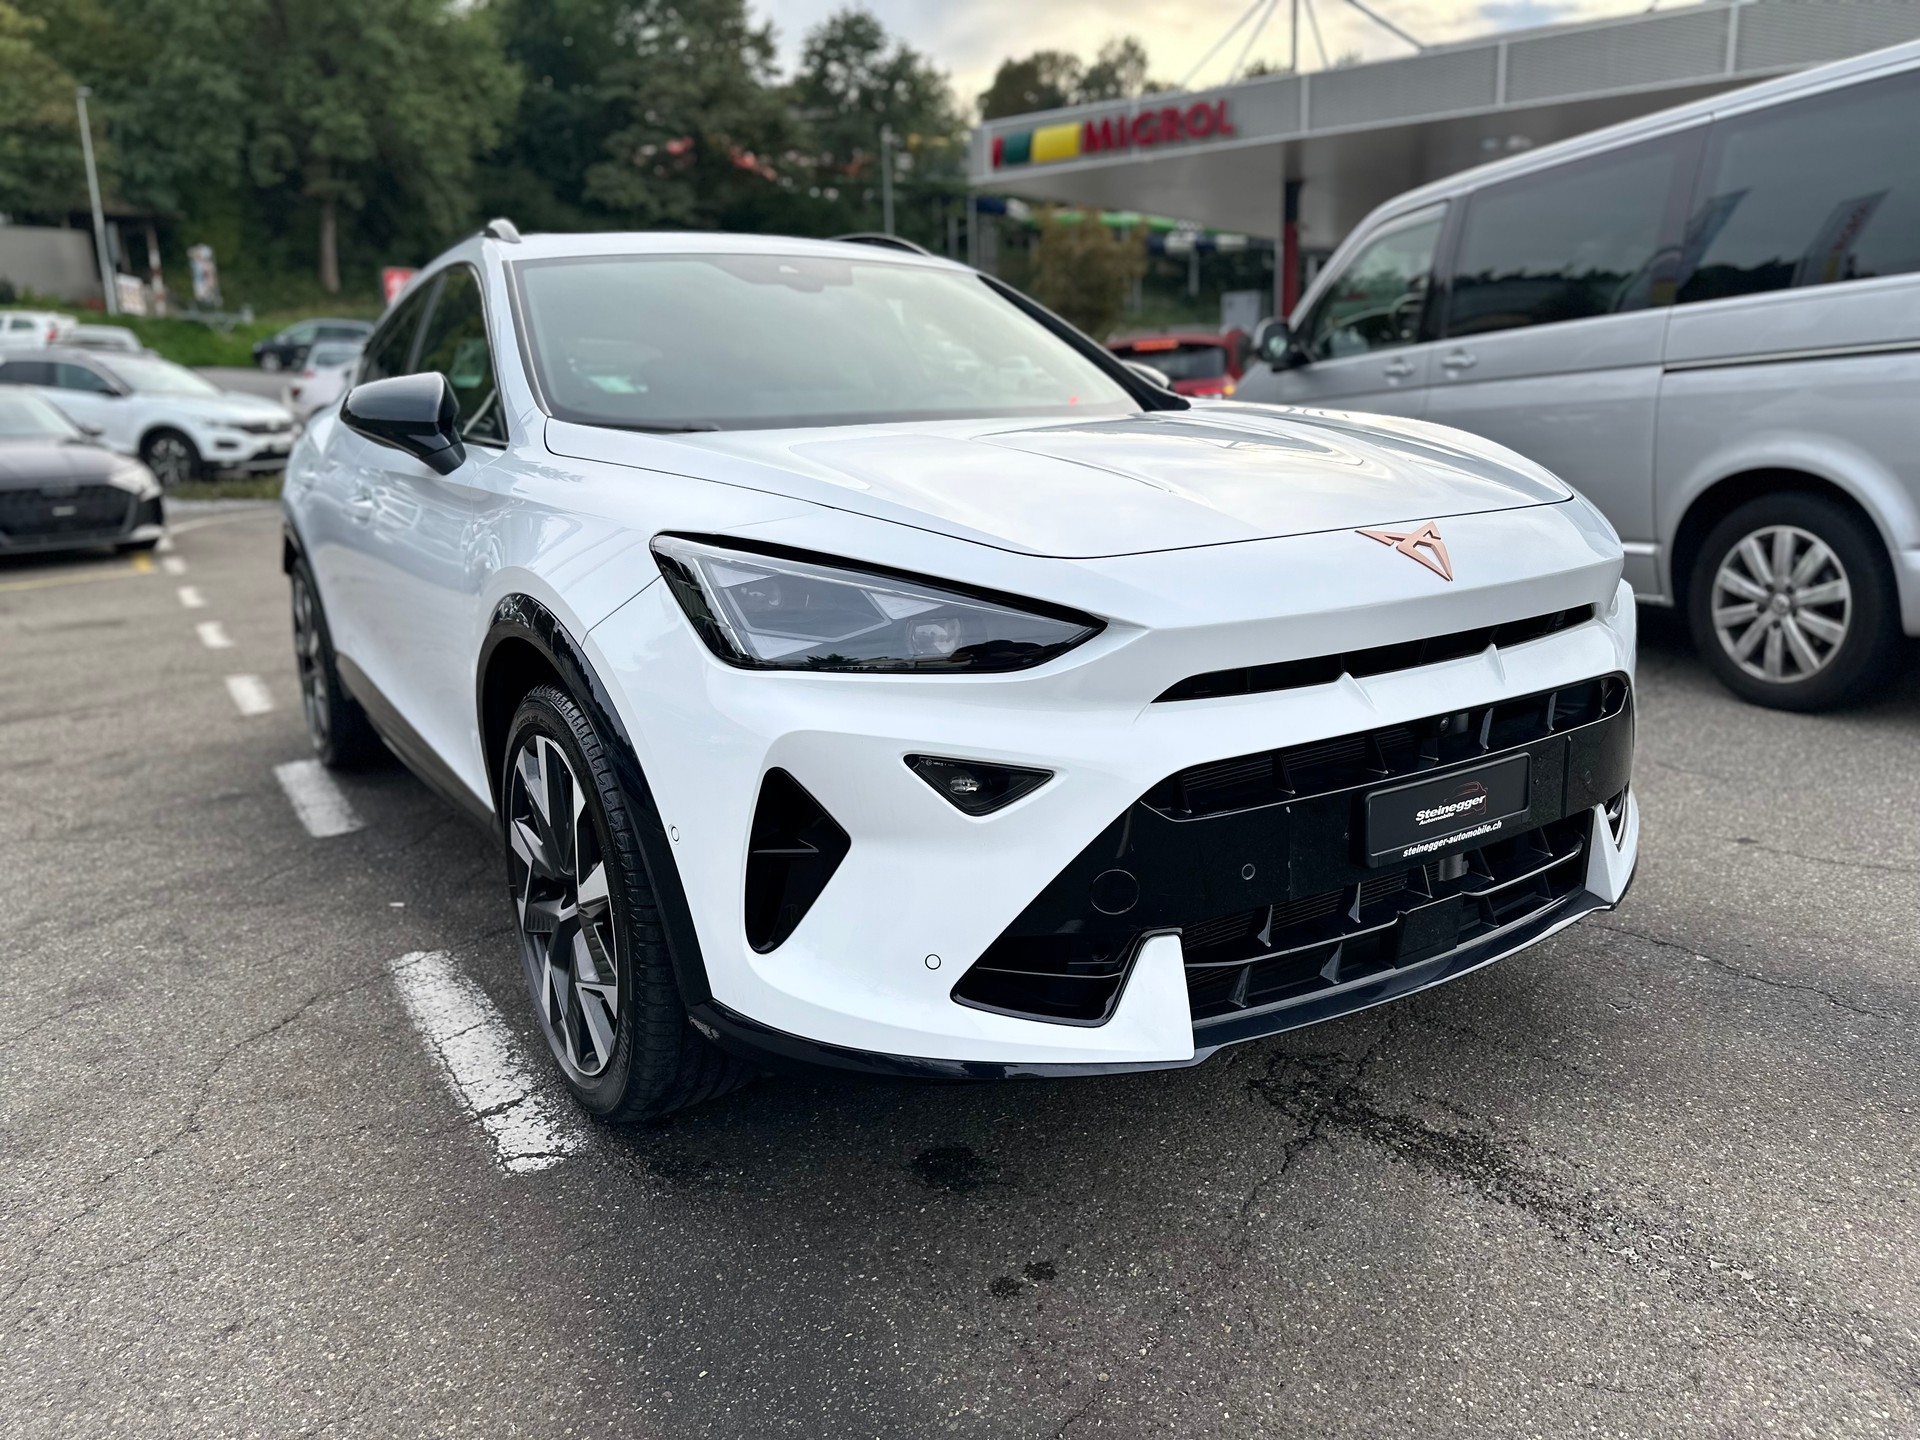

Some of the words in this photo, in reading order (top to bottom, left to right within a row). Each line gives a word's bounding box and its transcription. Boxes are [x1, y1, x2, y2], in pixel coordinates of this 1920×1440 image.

[1083, 99, 1234, 153] MIGROL
[1415, 795, 1486, 821] Steinegger
[1418, 813, 1455, 826] Automobile
[1403, 820, 1502, 857] steinegger-automobile.ch
